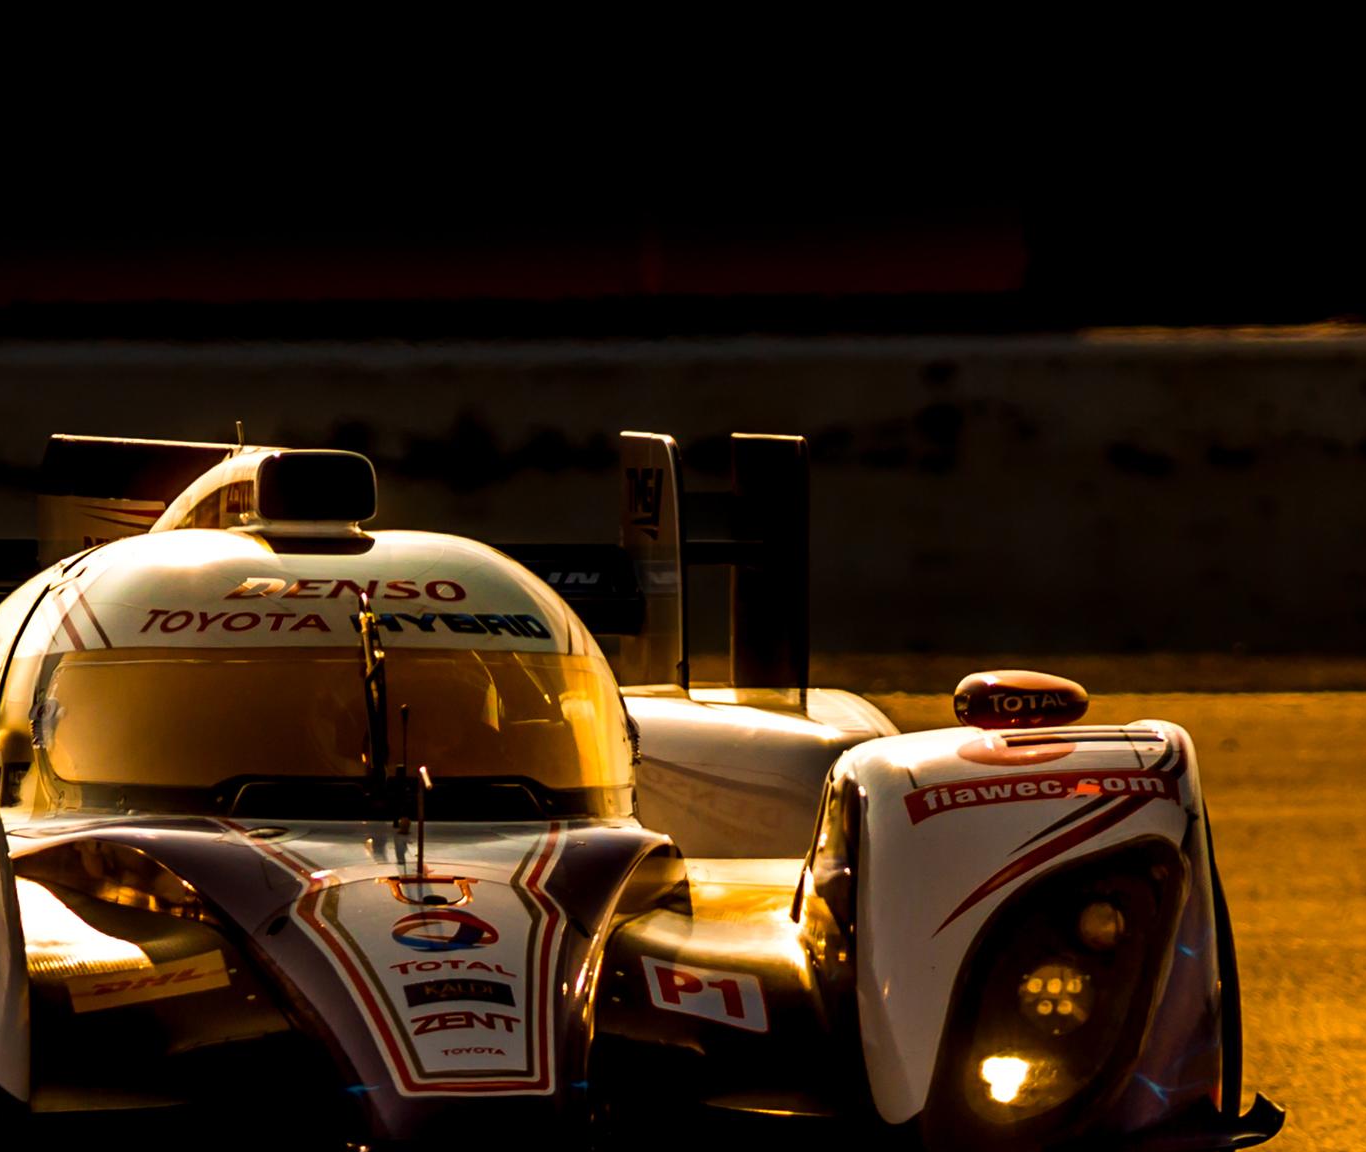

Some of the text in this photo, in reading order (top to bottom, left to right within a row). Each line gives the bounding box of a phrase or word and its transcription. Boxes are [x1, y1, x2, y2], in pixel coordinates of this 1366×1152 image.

[225, 578, 466, 601] DENSO
[140, 609, 552, 640] TOYOTA HYBRID
[988, 693, 1068, 713] TOTAL
[922, 776, 1165, 811] fiawec.com
[390, 960, 517, 978] TOTAL
[654, 967, 744, 1018] P1
[410, 1011, 521, 1036] ZENT
[442, 1047, 506, 1056] TOYOTA
